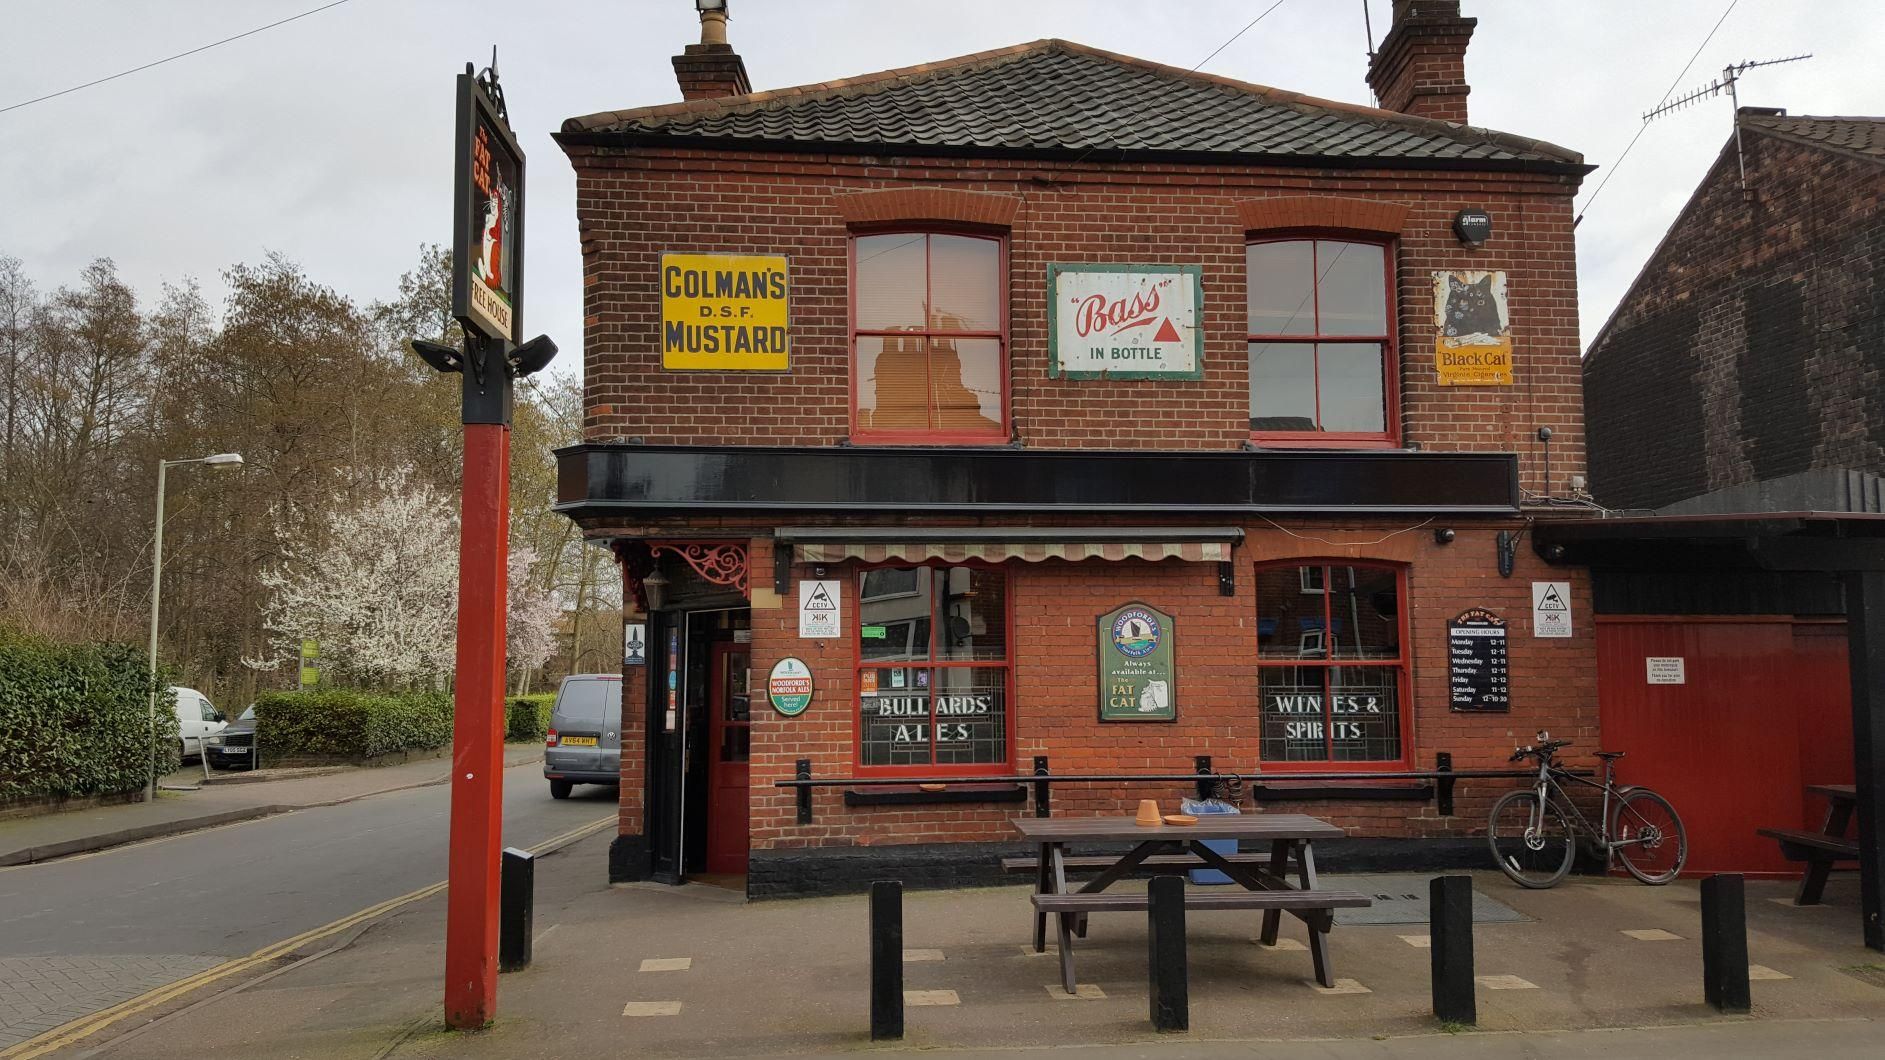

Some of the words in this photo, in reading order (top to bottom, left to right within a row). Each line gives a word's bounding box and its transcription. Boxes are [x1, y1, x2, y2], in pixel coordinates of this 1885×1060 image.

[474, 136, 491, 172] FAT
[473, 160, 491, 195] CAT
[665, 265, 786, 300] COLMAN'S
[487, 295, 508, 329] HOUSE
[699, 305, 754, 318] D.S.F.
[665, 320, 786, 354] MUSTARD
[1090, 347, 1104, 360] IN
[1111, 347, 1162, 360] BOTTLE
[1457, 611, 1470, 625] THE
[1124, 660, 1151, 668] Always
[1452, 667, 1476, 675] Thursday
[1112, 685, 1135, 695] FAT
[1110, 697, 1136, 708] CAT
[1275, 696, 1359, 713] WINES
[1366, 696, 1380, 713] &
[894, 723, 968, 742] ALES
[1286, 722, 1361, 739] SPIRITS
